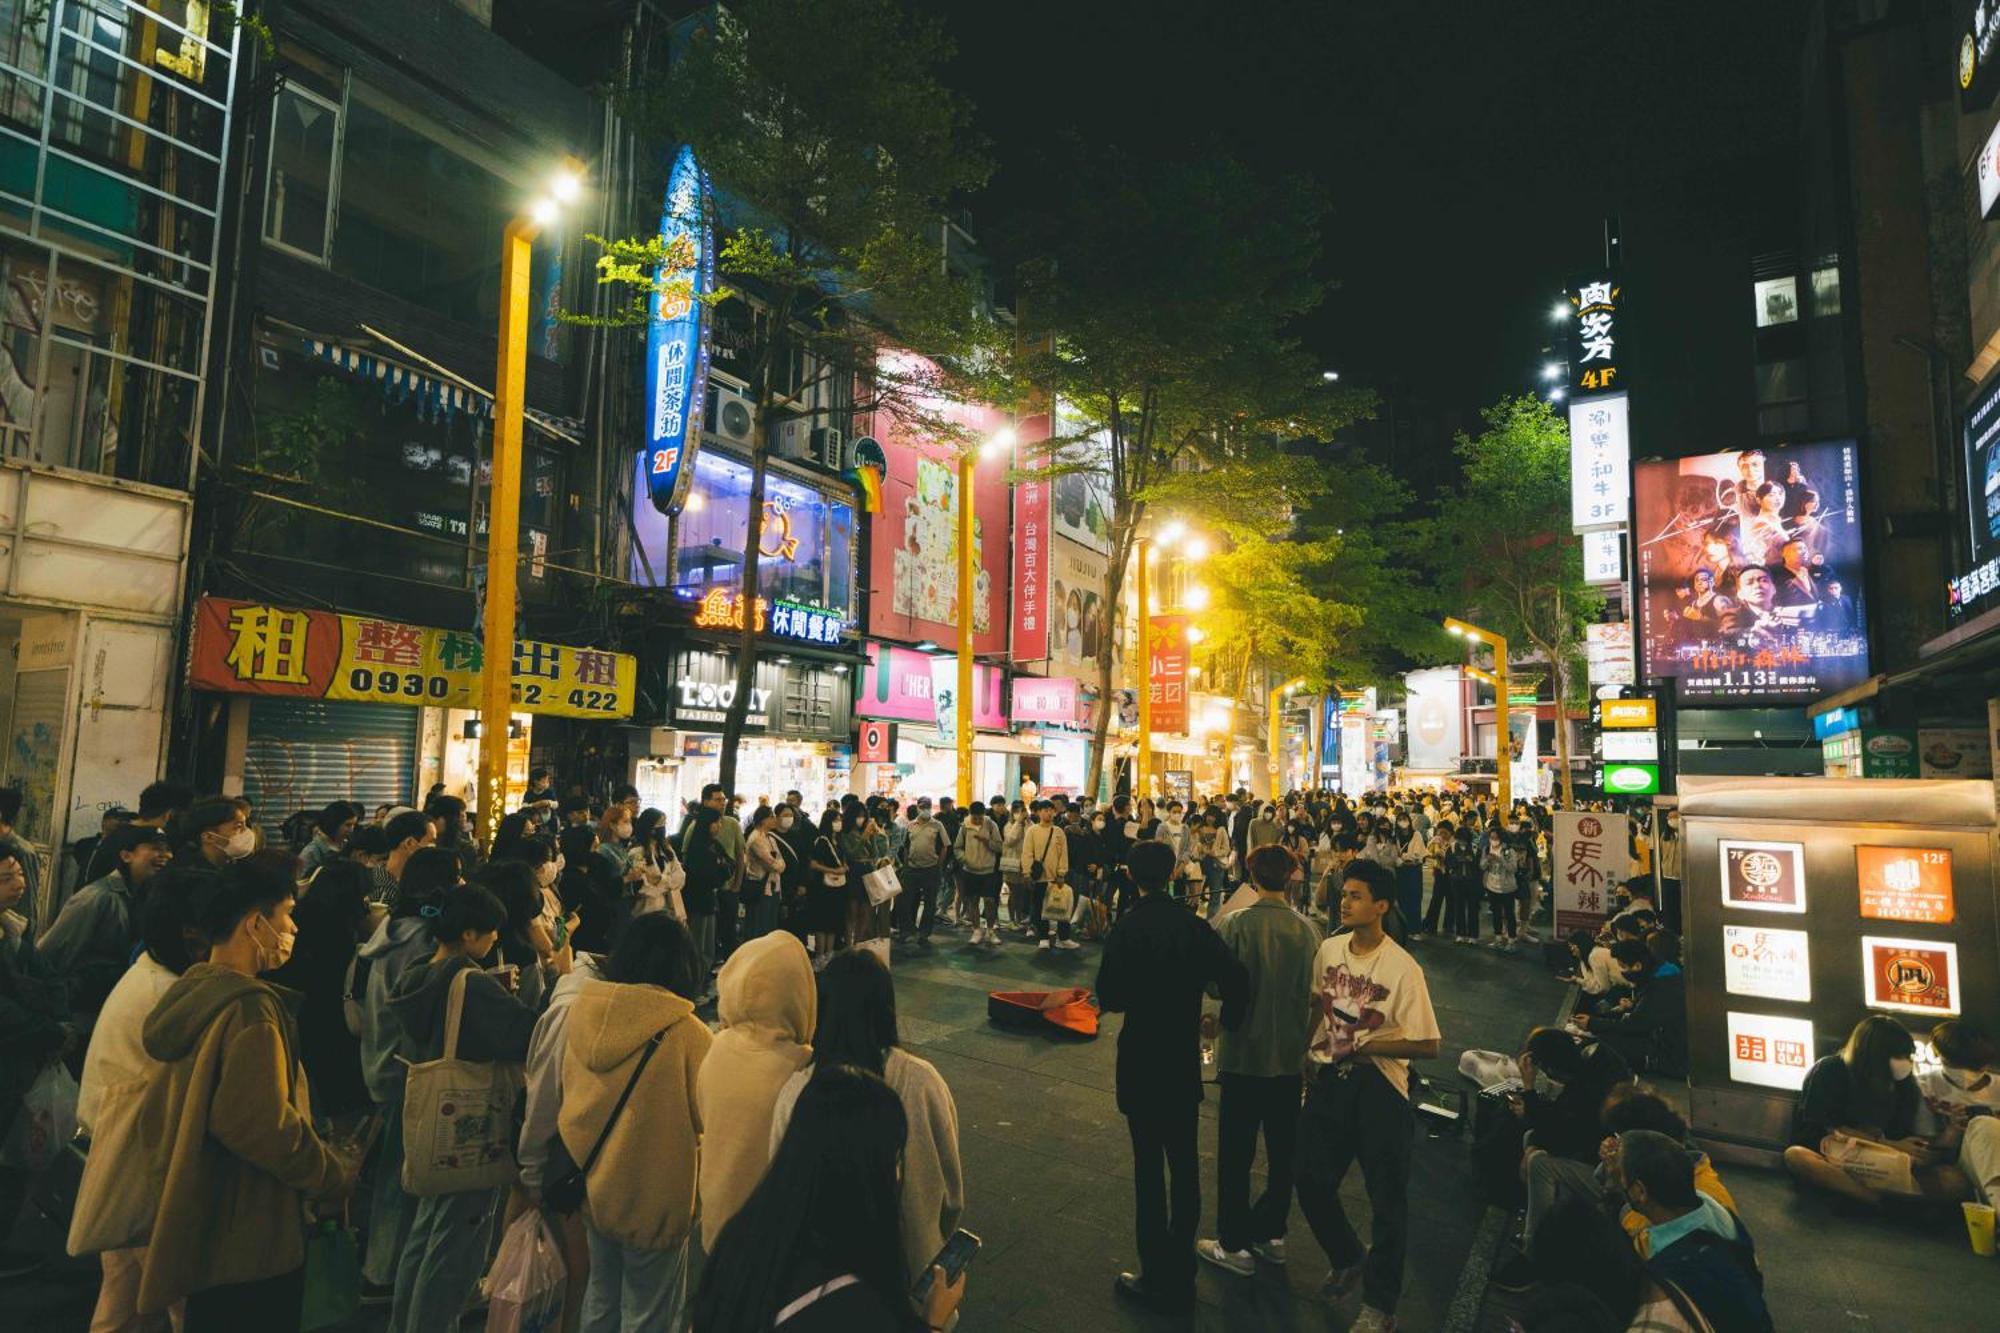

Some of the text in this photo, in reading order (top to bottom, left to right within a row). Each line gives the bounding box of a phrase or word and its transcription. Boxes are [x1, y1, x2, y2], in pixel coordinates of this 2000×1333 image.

[661, 341, 684, 437] 休閒茶坊
[1581, 368, 1616, 389] 4F
[653, 449, 678, 474] 2F
[1590, 504, 1616, 519] 3F
[1599, 562, 1619, 574] 3F
[772, 606, 841, 645] 休閒餐飲
[229, 605, 310, 685] 租
[1723, 671, 1767, 686] 1.13
[350, 668, 618, 712] 0930-2-422
[1729, 851, 1744, 860] 7F
[1922, 853, 1948, 865] 12F
